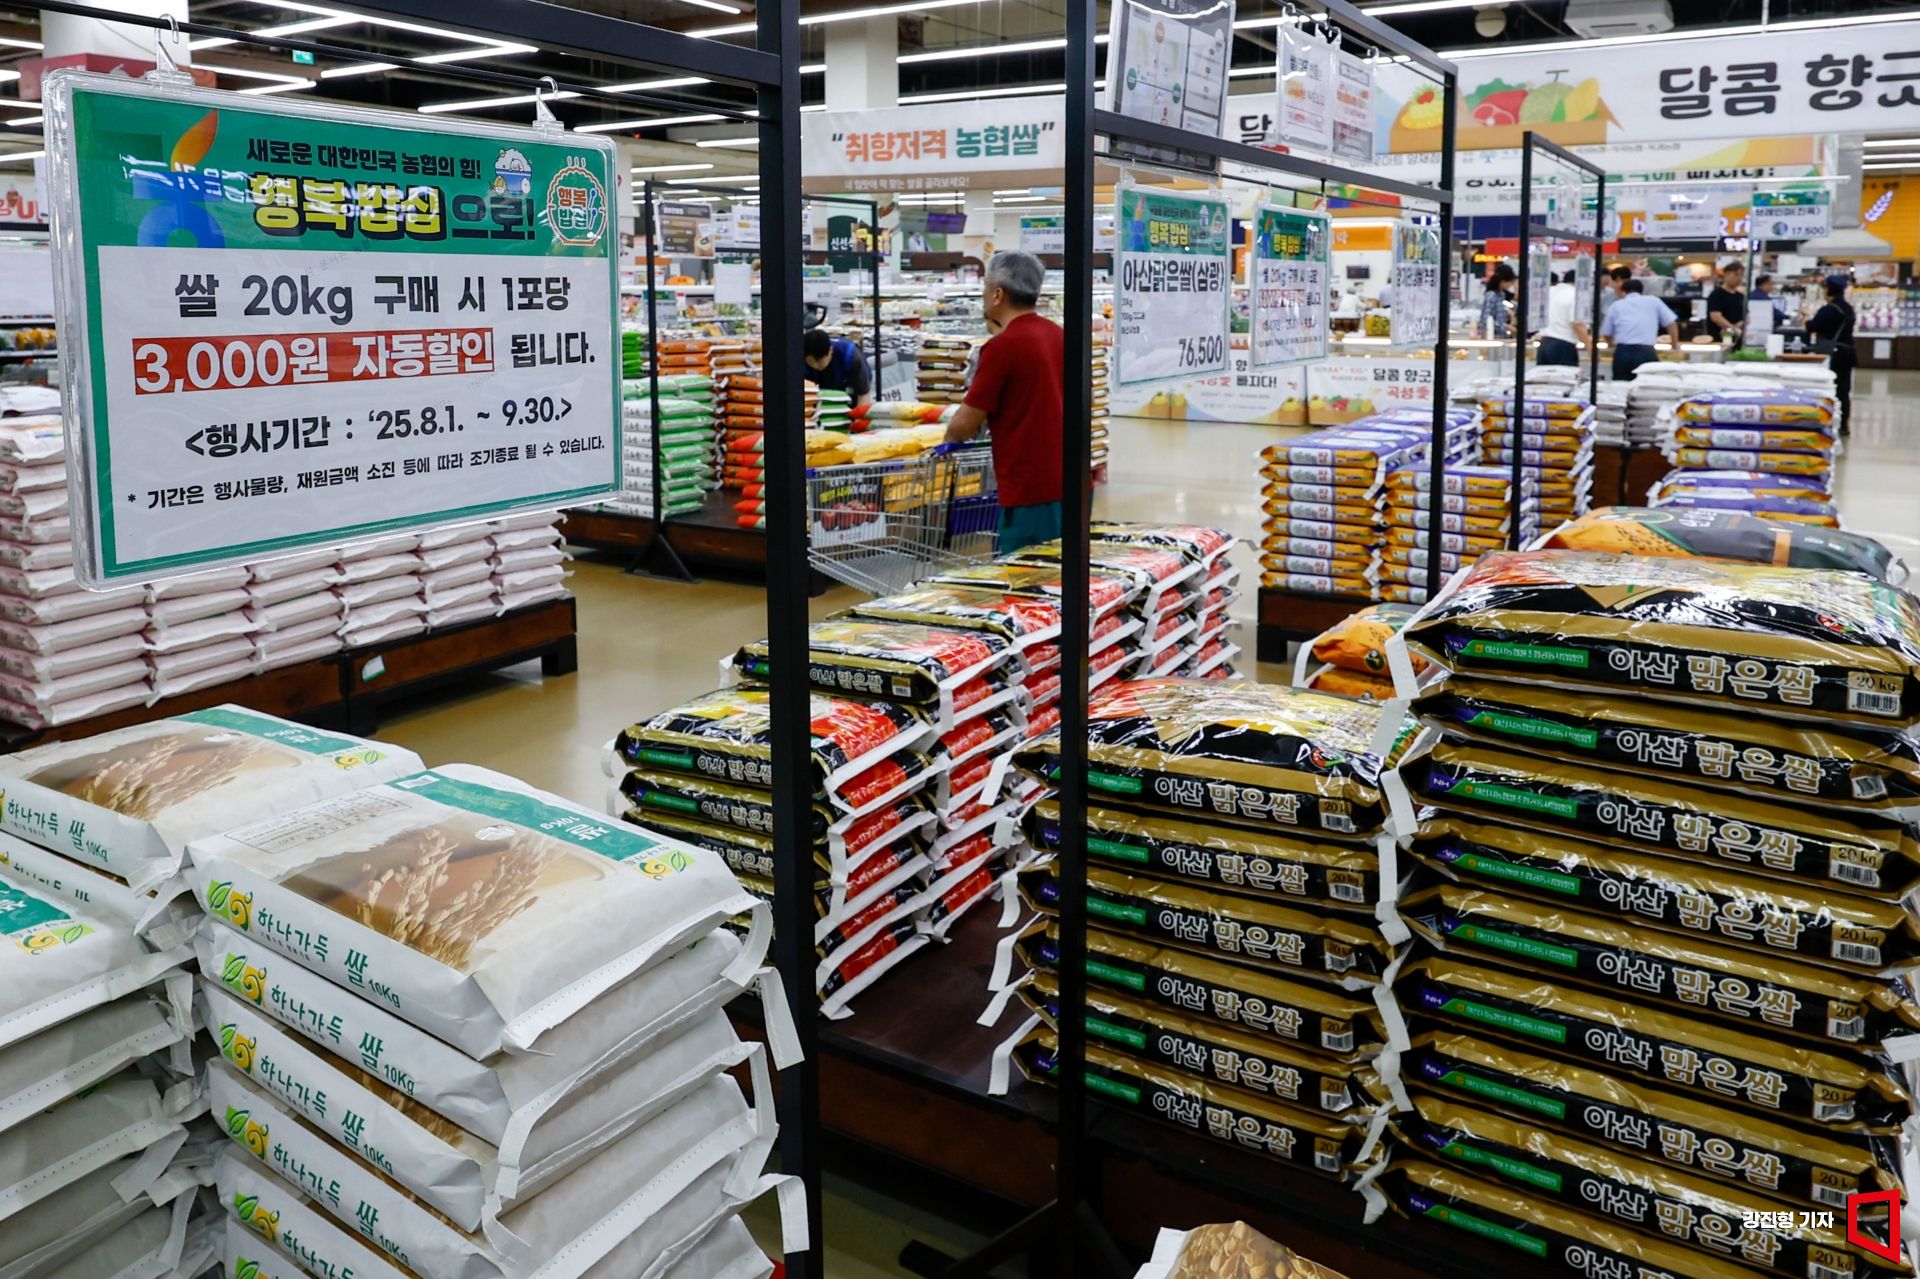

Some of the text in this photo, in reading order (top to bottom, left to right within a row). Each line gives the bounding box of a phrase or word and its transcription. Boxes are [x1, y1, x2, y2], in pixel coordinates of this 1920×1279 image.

[1659, 62, 1781, 120] 달콤
[246, 138, 481, 180] 새로운 대한민국 농협의 힘!
[832, 121, 1055, 162] “취향저격 농협쌀”
[175, 274, 570, 325] 쌀 20kg 구매 시 1포당
[135, 331, 596, 393] 3,000원 자동할인 됩니다.
[1179, 335, 1223, 368] 76,500
[185, 415, 331, 458] <행사기간
[502, 396, 572, 426] 9.30.>
[148, 435, 605, 509] 기간은 행사물량, 재원금액 소진 등에 따라 조기종료 될 수 있습니다.
[810, 667, 836, 687] 아산
[1608, 648, 1820, 705] 아산 맑은쌀
[1857, 675, 1897, 692] 20 kg
[697, 755, 727, 776] 아산
[1616, 729, 1826, 794] 아산 맑은쌀
[701, 801, 729, 822] 아산
[1155, 777, 1204, 807] 아산
[1207, 783, 1300, 824] 맑은쌀
[1324, 802, 1338, 813] 20
[8, 799, 108, 863] 하나가득 쌀 10Kg
[1596, 801, 1803, 871] 아산 맑은쌀
[1838, 847, 1877, 866] 20 kg
[1162, 847, 1212, 878] 아산
[1216, 854, 1309, 895] 맑은쌀
[1332, 872, 1345, 882] 20
[1159, 910, 1305, 965] 아산 맑은쌀
[1600, 878, 1805, 950] 아산 맑은쌀
[1840, 927, 1879, 947] 20 kg
[258, 908, 328, 963] 하나가득
[344, 949, 368, 989] 쌀
[368, 979, 401, 1008] 10Kg
[1158, 976, 1302, 1039] 아산 맑은쌀
[1596, 952, 1801, 1027] 아산 맑은쌀
[1836, 1005, 1852, 1018] 20
[271, 984, 415, 1096] 하나가득 쌀 10Kg
[1158, 1035, 1302, 1100] 아산 맑은쌀
[1585, 1028, 1787, 1108] 아산 맑은쌀
[260, 1056, 393, 1175] 하나가득 쌀 10Kg
[1822, 1088, 1840, 1102] 20
[1153, 1091, 1296, 1159] 아산 맑은쌀
[1584, 1105, 1786, 1190] 아산 맑은쌀
[273, 1144, 411, 1266] 하나가득 쌀 10Kg
[1819, 1171, 1838, 1185] 20
[1580, 1178, 1783, 1267] 아산 맑은쌀
[1815, 1251, 1834, 1265] 20
